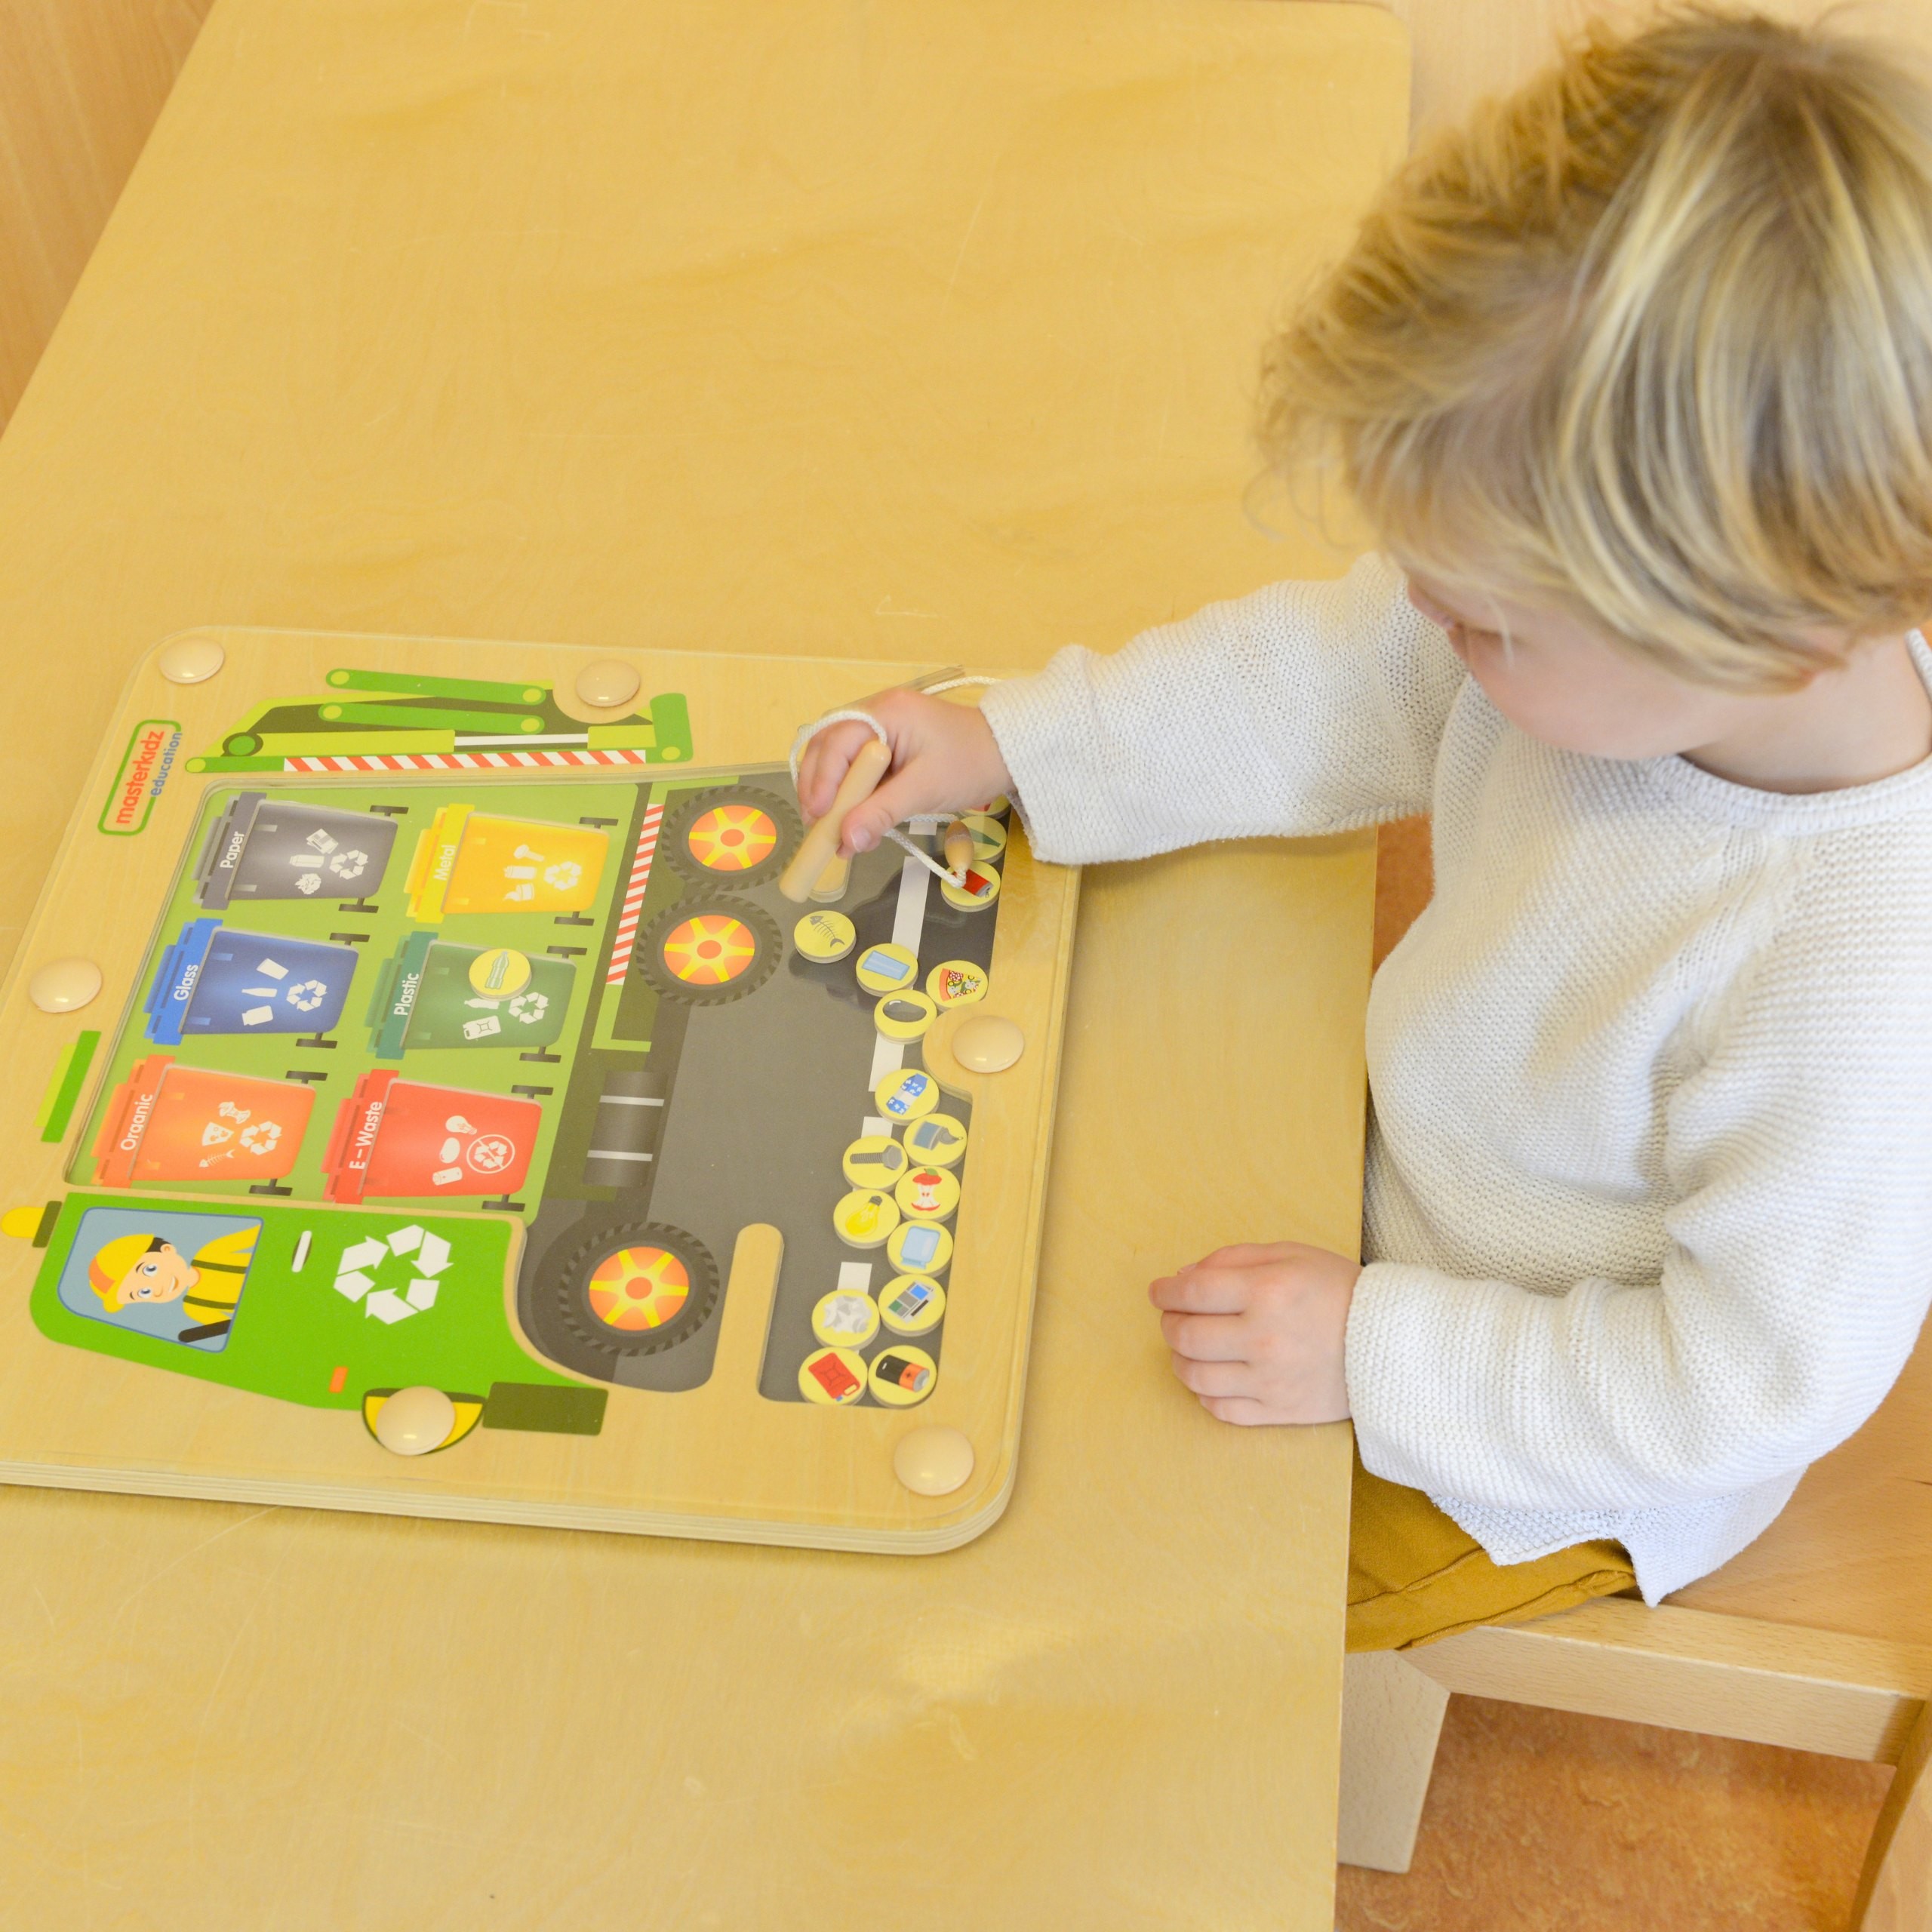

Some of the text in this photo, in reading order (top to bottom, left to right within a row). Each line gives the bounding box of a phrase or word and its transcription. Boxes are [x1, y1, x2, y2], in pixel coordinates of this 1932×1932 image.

[115, 731, 165, 824] masterkidz
[150, 732, 183, 797] education
[220, 831, 245, 869] Paper
[433, 844, 457, 881] Metal
[174, 964, 198, 1001] Glass
[393, 973, 420, 1016] Plastic
[120, 1094, 153, 1151] Organic
